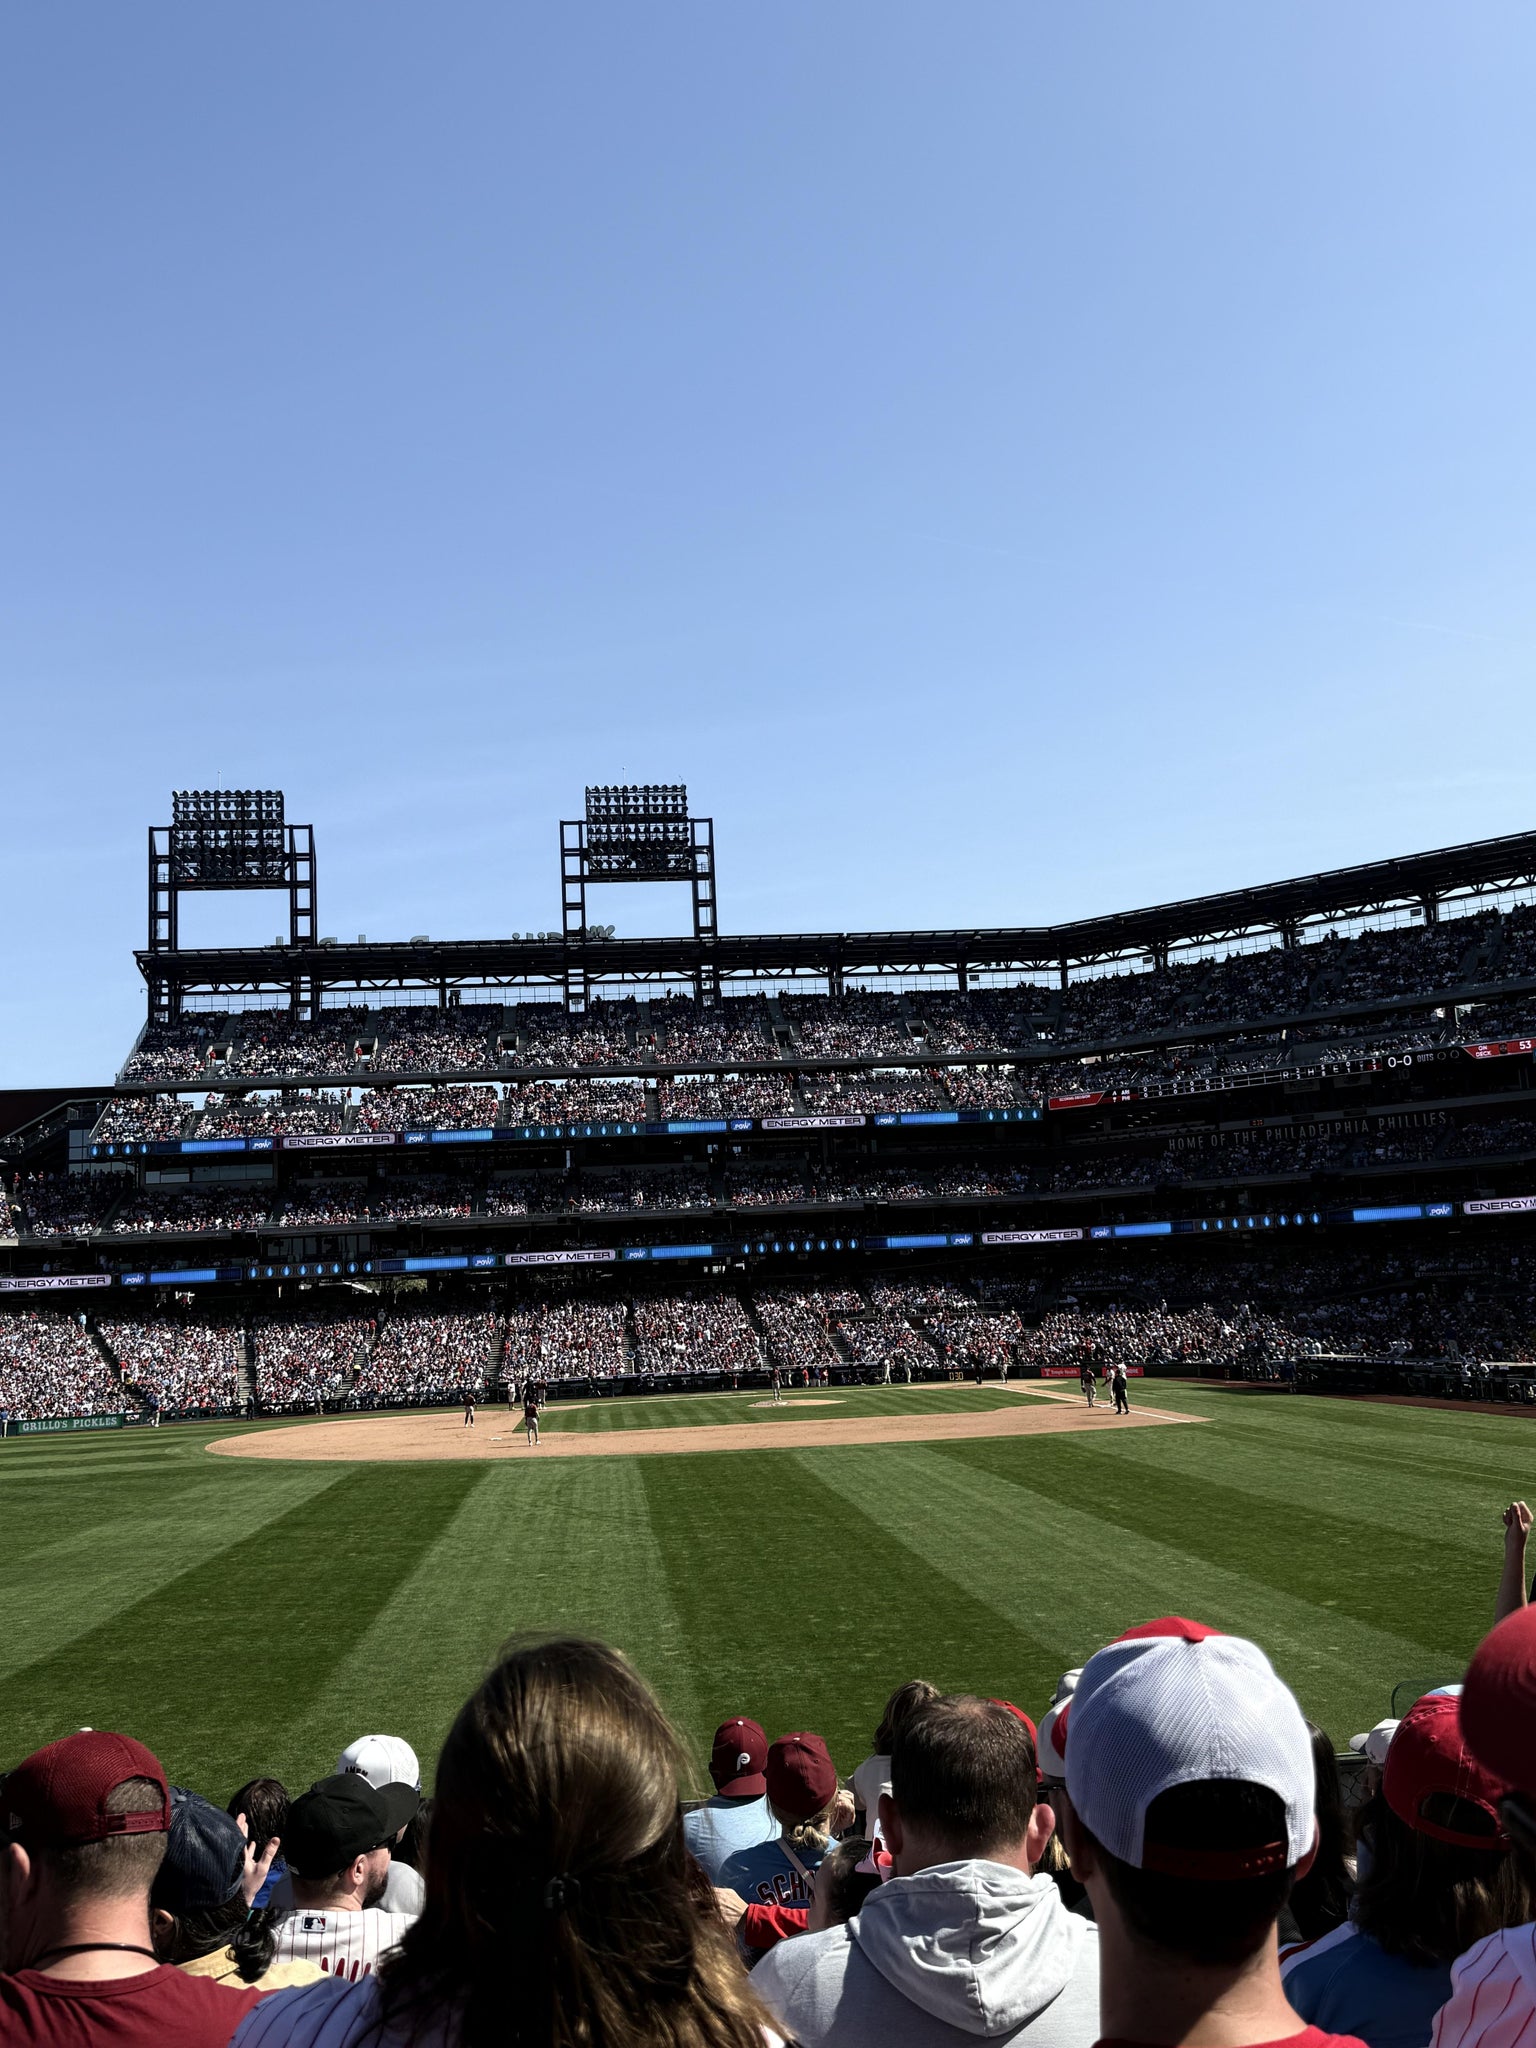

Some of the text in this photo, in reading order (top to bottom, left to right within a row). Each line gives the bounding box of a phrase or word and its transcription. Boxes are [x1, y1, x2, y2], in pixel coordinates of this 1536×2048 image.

[1519, 1040, 1531, 1050] 53
[1388, 1053, 1434, 1068] 0-0 OUTS
[1283, 1071, 1289, 1079] R
[1333, 1065, 1338, 1073] E
[767, 1117, 861, 1128] ENERGY METER
[1168, 1136, 1204, 1151] HOME
[1210, 1133, 1225, 1147] OF
[1233, 1130, 1257, 1145] THE
[1266, 1119, 1369, 1142] PHILADELPHIA
[1378, 1111, 1446, 1130] PHILLIES
[289, 1135, 390, 1147] ENERGY METER
[1470, 1200, 1528, 1212] ENERGY
[987, 1230, 1079, 1242] ENERGY METER
[511, 1251, 611, 1263] ENERGY METER
[0, 1276, 106, 1289] ENERGY METER
[22, 1416, 117, 1431] GRILLO'S PICKLES
[736, 1752, 751, 1771] P
